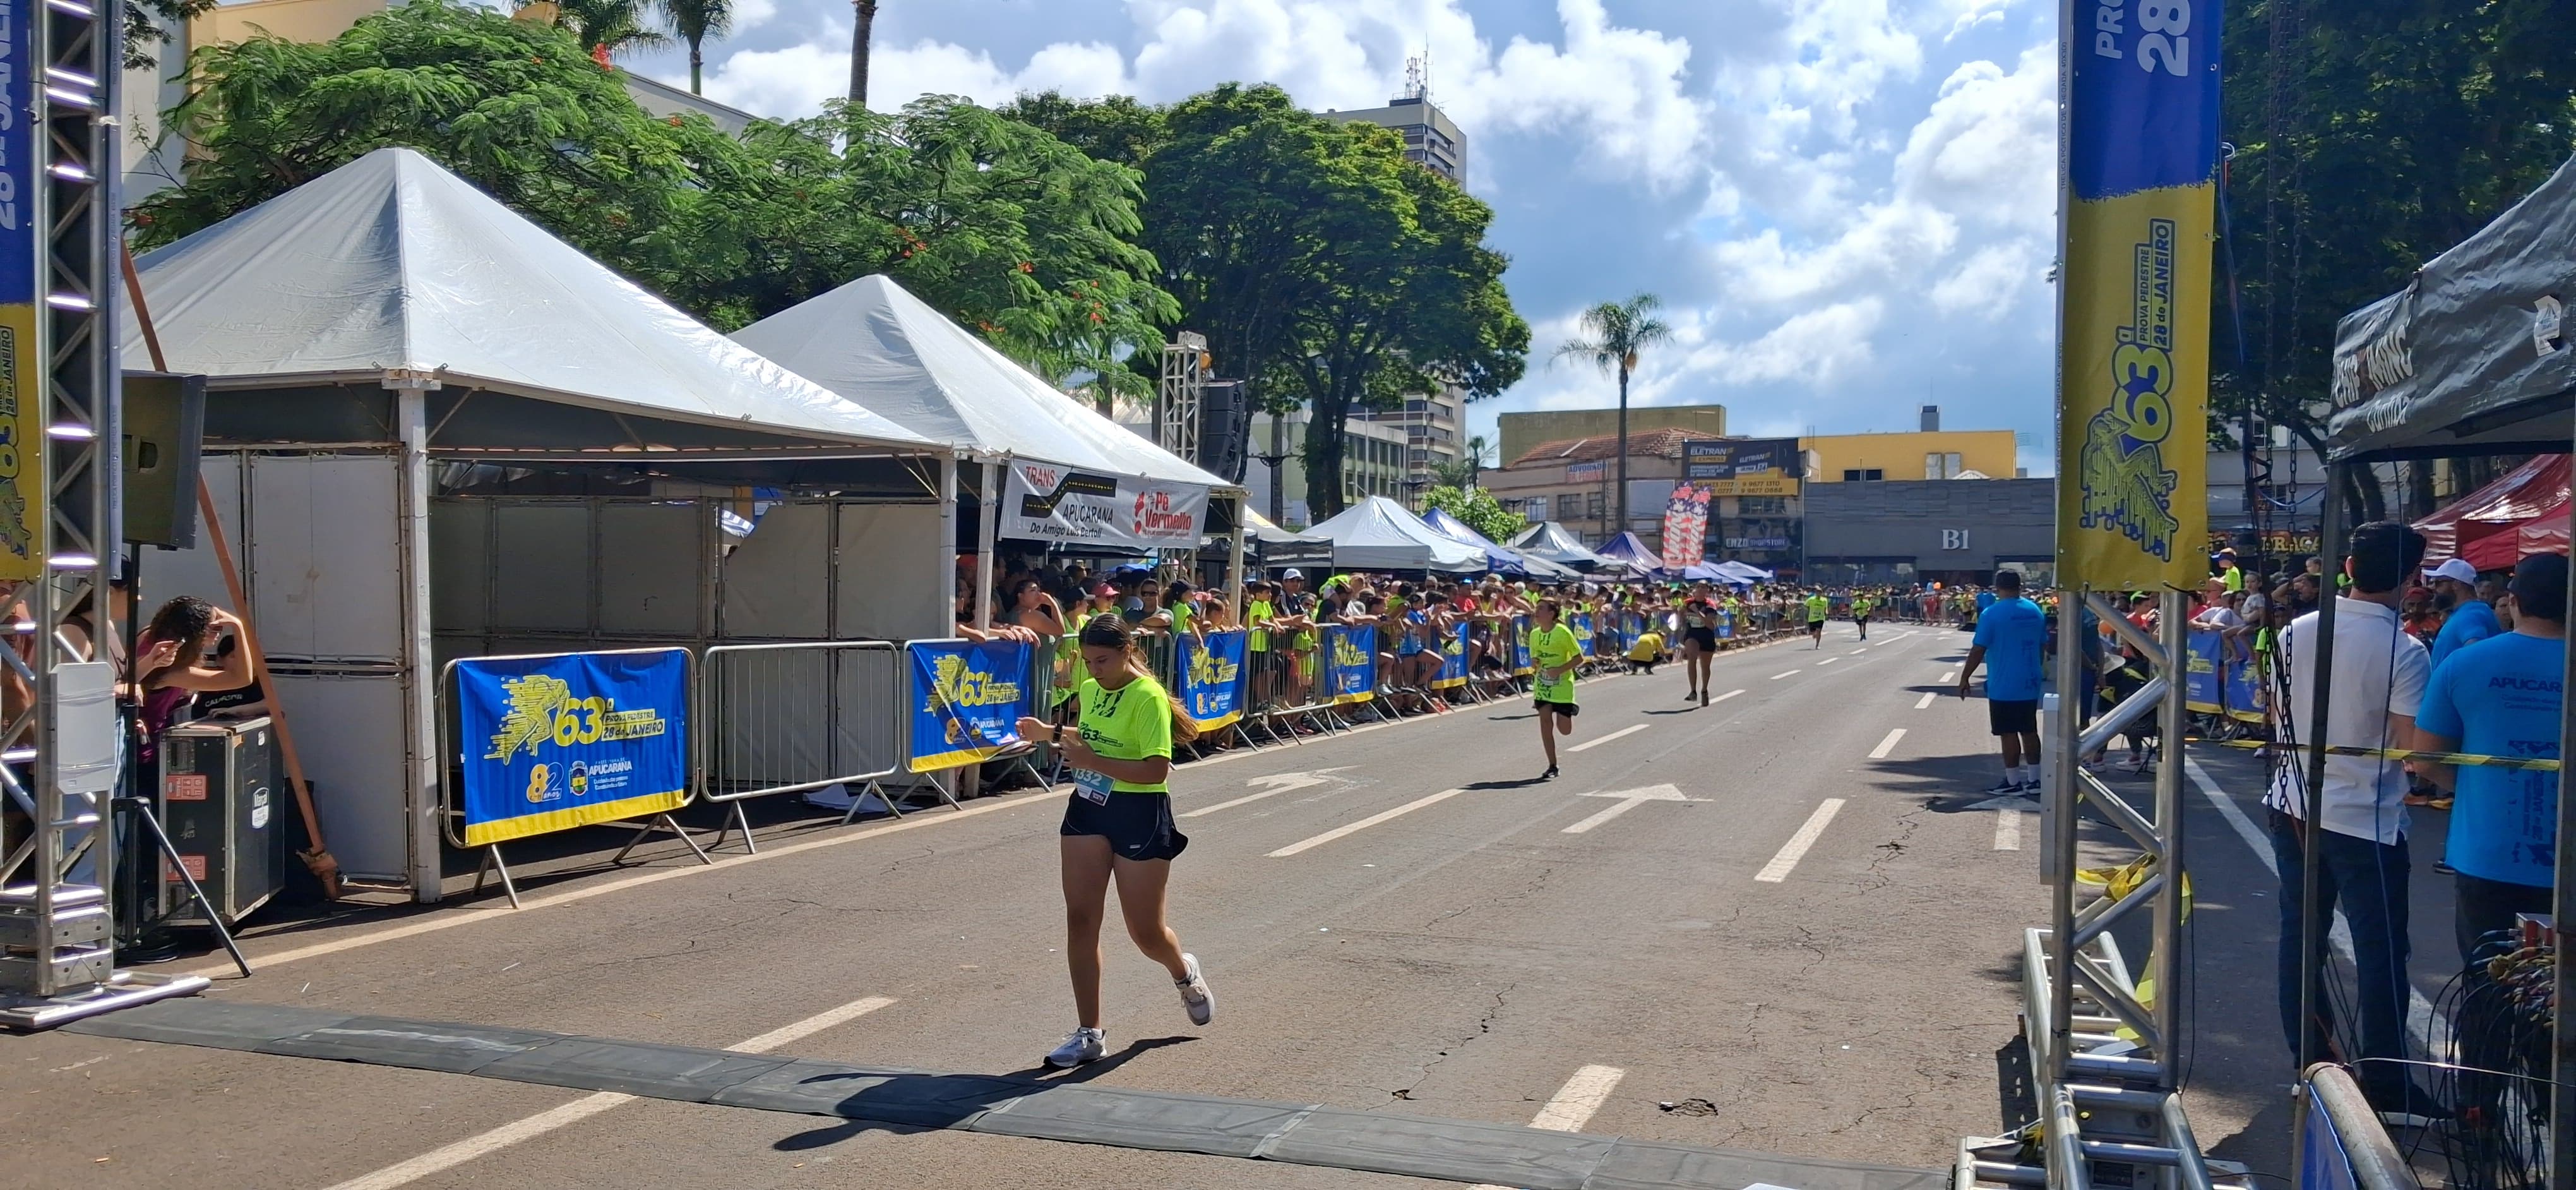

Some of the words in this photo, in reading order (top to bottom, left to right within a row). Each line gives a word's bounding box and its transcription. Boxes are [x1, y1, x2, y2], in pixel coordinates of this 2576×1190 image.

[2154, 224, 2170, 304] JANEIRO
[2139, 248, 2150, 303] PEDESTRE
[2139, 306, 2150, 342] PROVA
[2154, 306, 2166, 322] de
[2153, 325, 2168, 346] 28
[1691, 447, 1727, 455] ELETRAN
[1025, 466, 1056, 488] TRANS
[1155, 491, 1169, 512] Pé
[1062, 503, 1114, 525] APUCARANA
[1145, 508, 1192, 531] Vermelho
[1030, 522, 1041, 533] Do
[1042, 524, 1066, 537] Amigo
[605, 713, 627, 723] PROVA
[604, 727, 615, 739] 28
[616, 728, 625, 736] de
[626, 721, 664, 736] JANEIRO
[588, 760, 633, 776] APUCARANA
